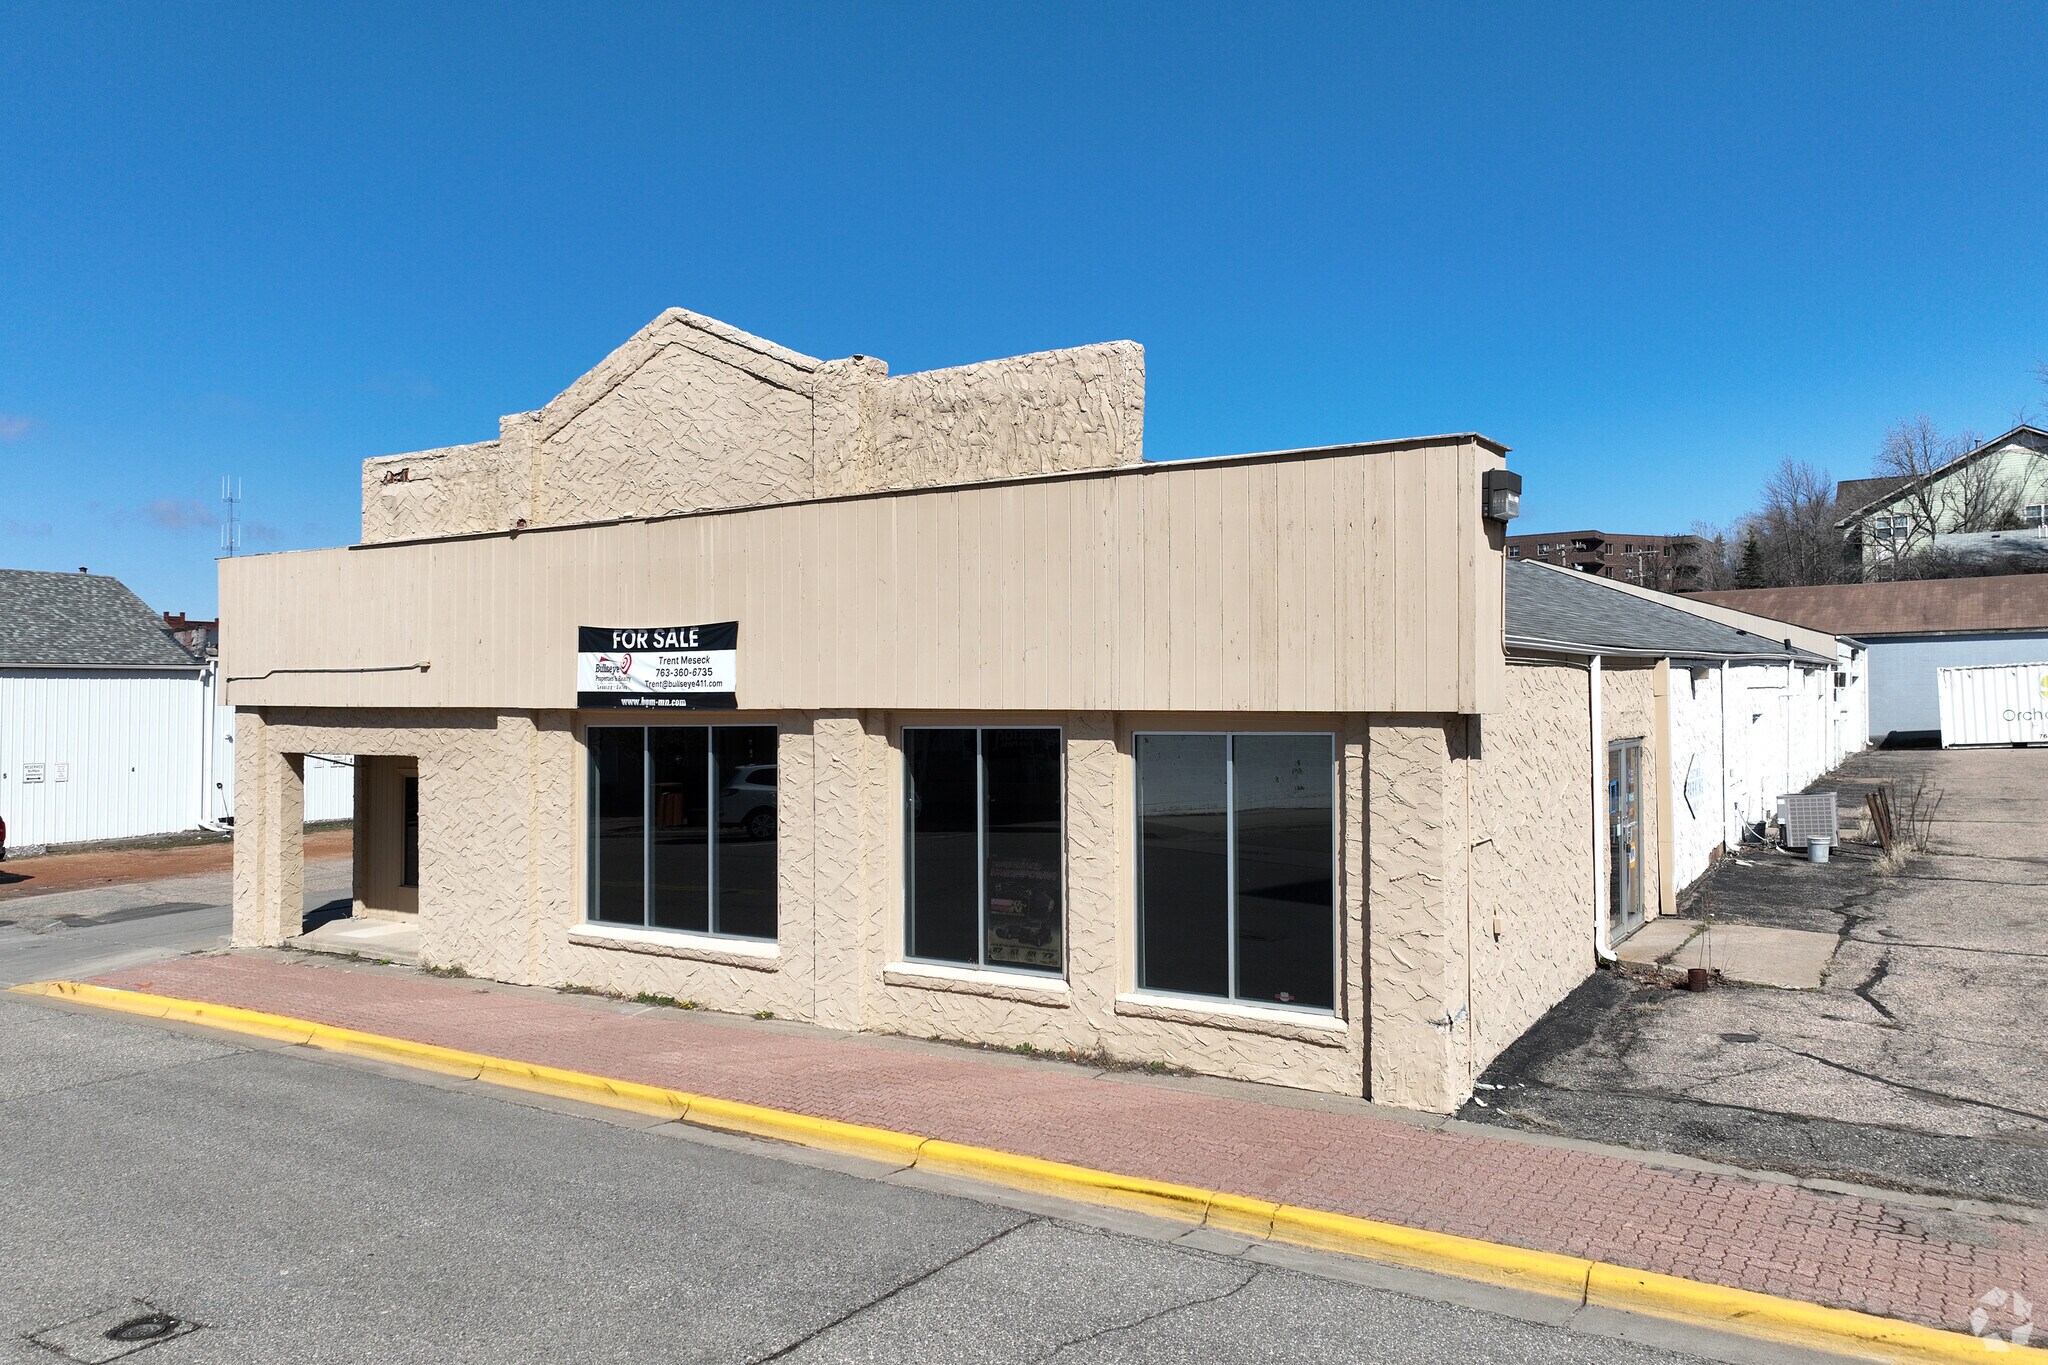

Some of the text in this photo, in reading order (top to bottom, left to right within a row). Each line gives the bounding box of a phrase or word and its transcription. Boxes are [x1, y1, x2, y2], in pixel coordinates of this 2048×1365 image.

[613, 628, 699, 649] FOR SALE
[659, 655, 711, 665] Trent Meseck
[595, 663, 620, 675] Bullseye
[656, 667, 713, 677] 763-360-6735
[645, 679, 723, 689] Trent@bullseye411.com
[2003, 708, 2048, 721] Orch
